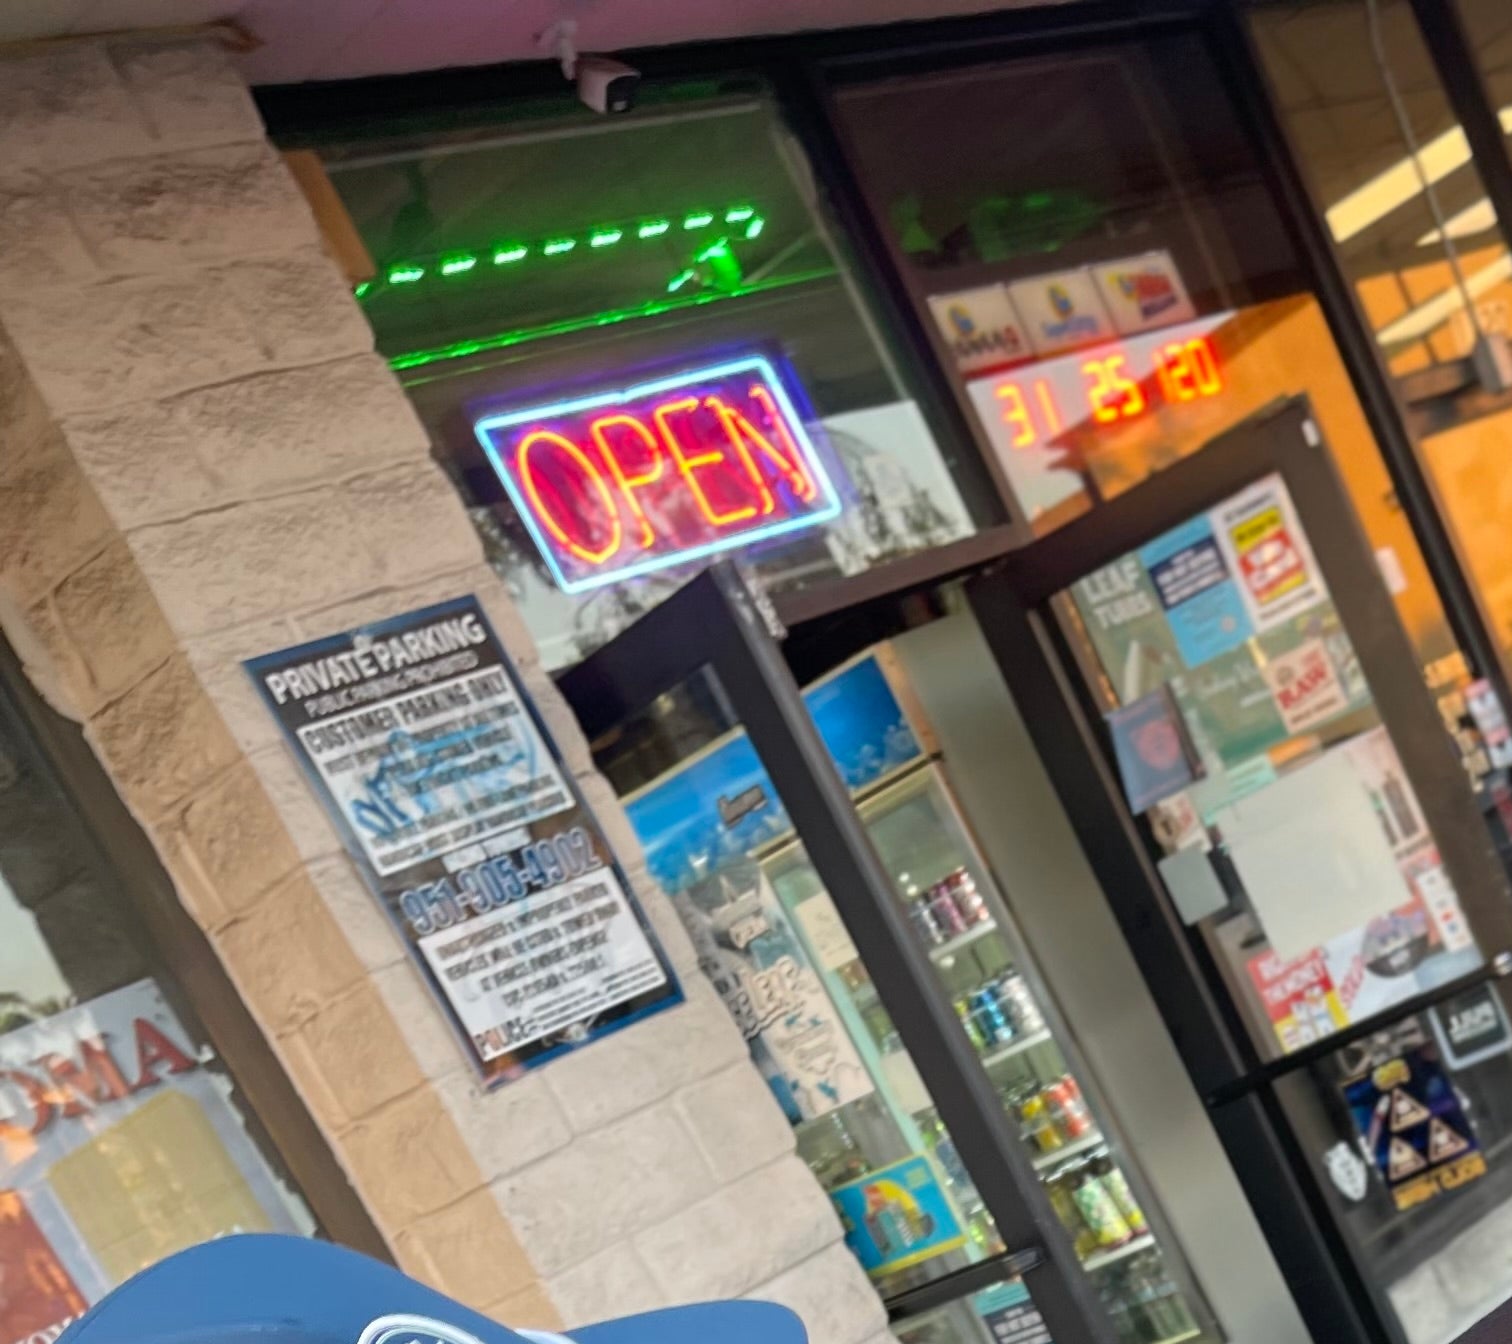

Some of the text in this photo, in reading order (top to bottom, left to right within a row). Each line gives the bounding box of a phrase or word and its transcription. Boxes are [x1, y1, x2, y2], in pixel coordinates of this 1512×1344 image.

[1082, 355, 1145, 422] 25
[517, 384, 817, 564] OPEN
[264, 613, 488, 705] PRIVATE PARKING
[303, 704, 397, 755] CUSTOMER
